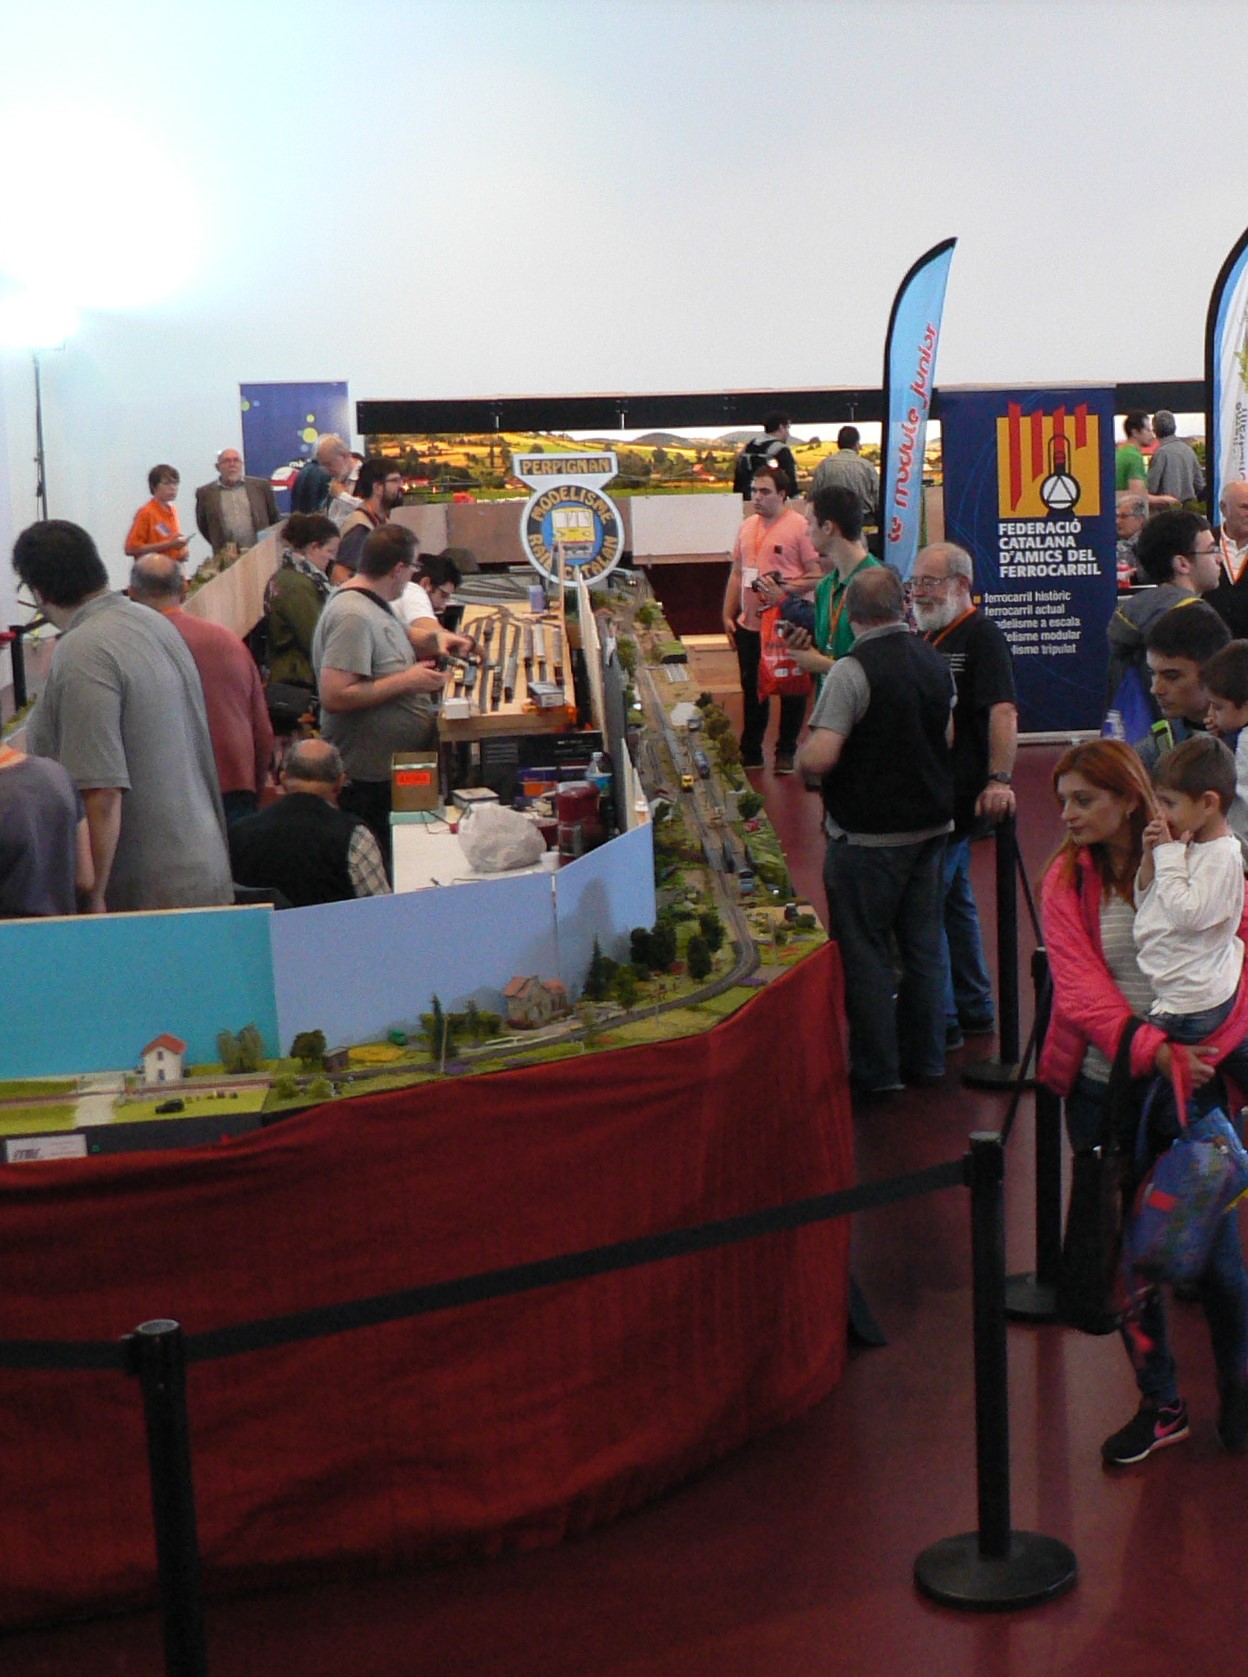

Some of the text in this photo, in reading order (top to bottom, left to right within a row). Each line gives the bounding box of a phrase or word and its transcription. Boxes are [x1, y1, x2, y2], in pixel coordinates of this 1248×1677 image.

[910, 321, 937, 410] junior
[521, 457, 611, 475] PERPIGNAN
[531, 486, 615, 525] MODELISME
[998, 518, 1081, 536] FEDERACIÓ
[999, 536, 1076, 550] CATALANA
[999, 549, 1096, 564] D'AMICS DEL
[999, 563, 1102, 578] FERROCARRIL
[984, 589, 1071, 604] ferrocarril històric
[984, 604, 1065, 617] ferrocarril actual
[1040, 618, 1047, 628] a
[1049, 616, 1081, 627] escala
[1041, 630, 1081, 640] modular
[1041, 643, 1076, 656] tripulat
